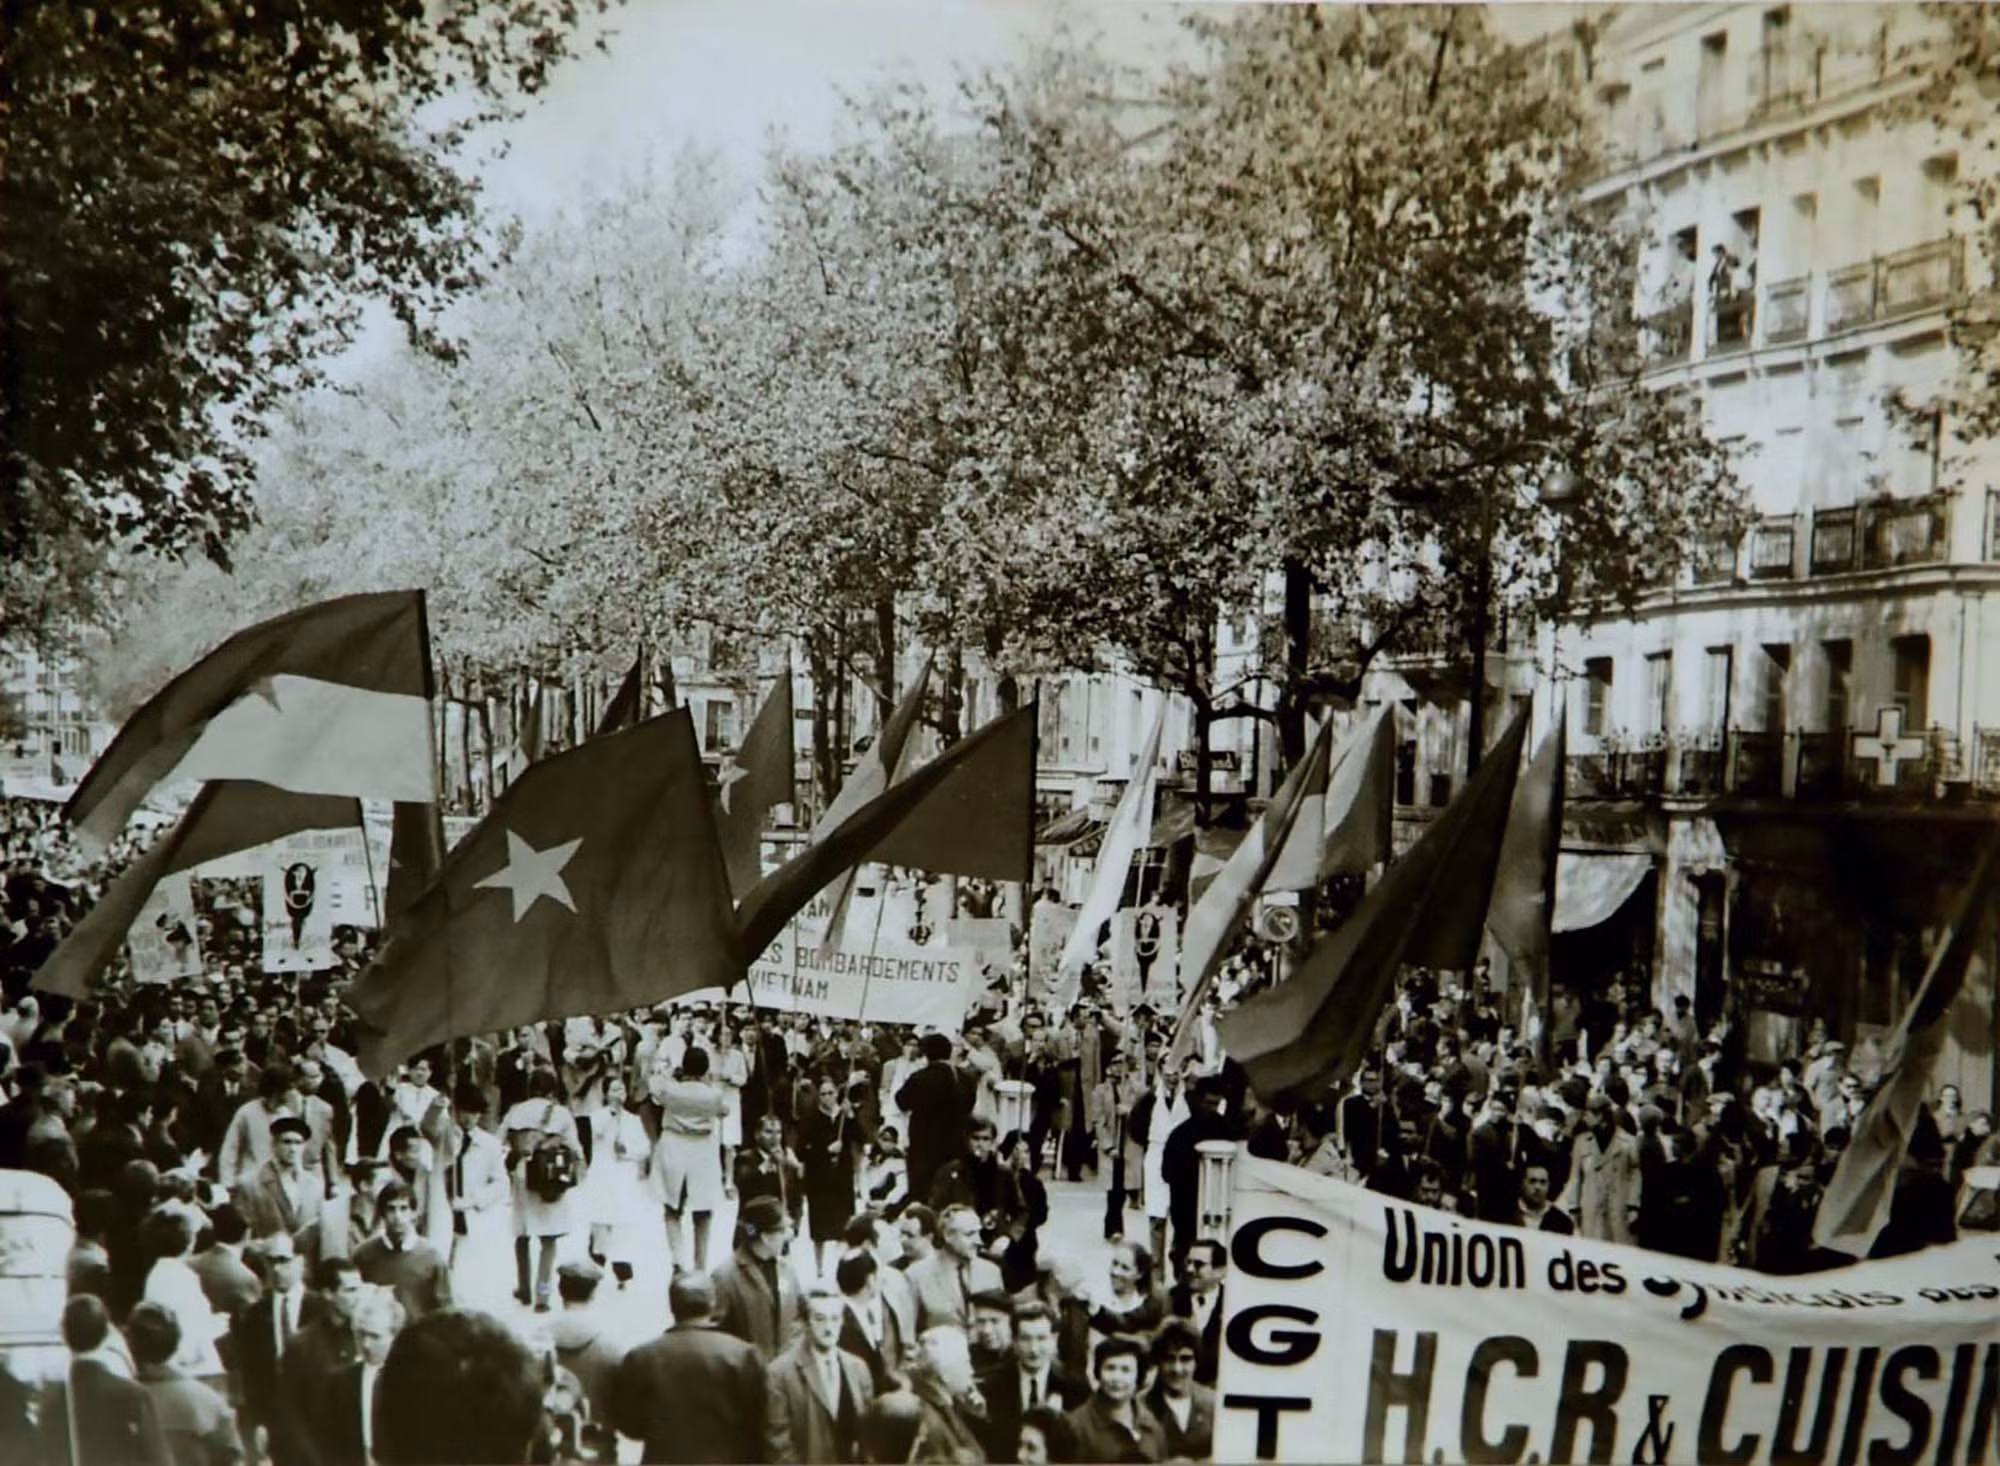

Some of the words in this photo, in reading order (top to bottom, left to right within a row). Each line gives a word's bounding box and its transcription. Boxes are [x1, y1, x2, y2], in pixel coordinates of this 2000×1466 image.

[751, 969, 829, 1000] VIETNAM
[1383, 1206, 1525, 1290] Union
[1548, 1249, 1627, 1294] des
[1224, 1215, 1329, 1460] CGT
[1632, 1395, 1675, 1465] &
